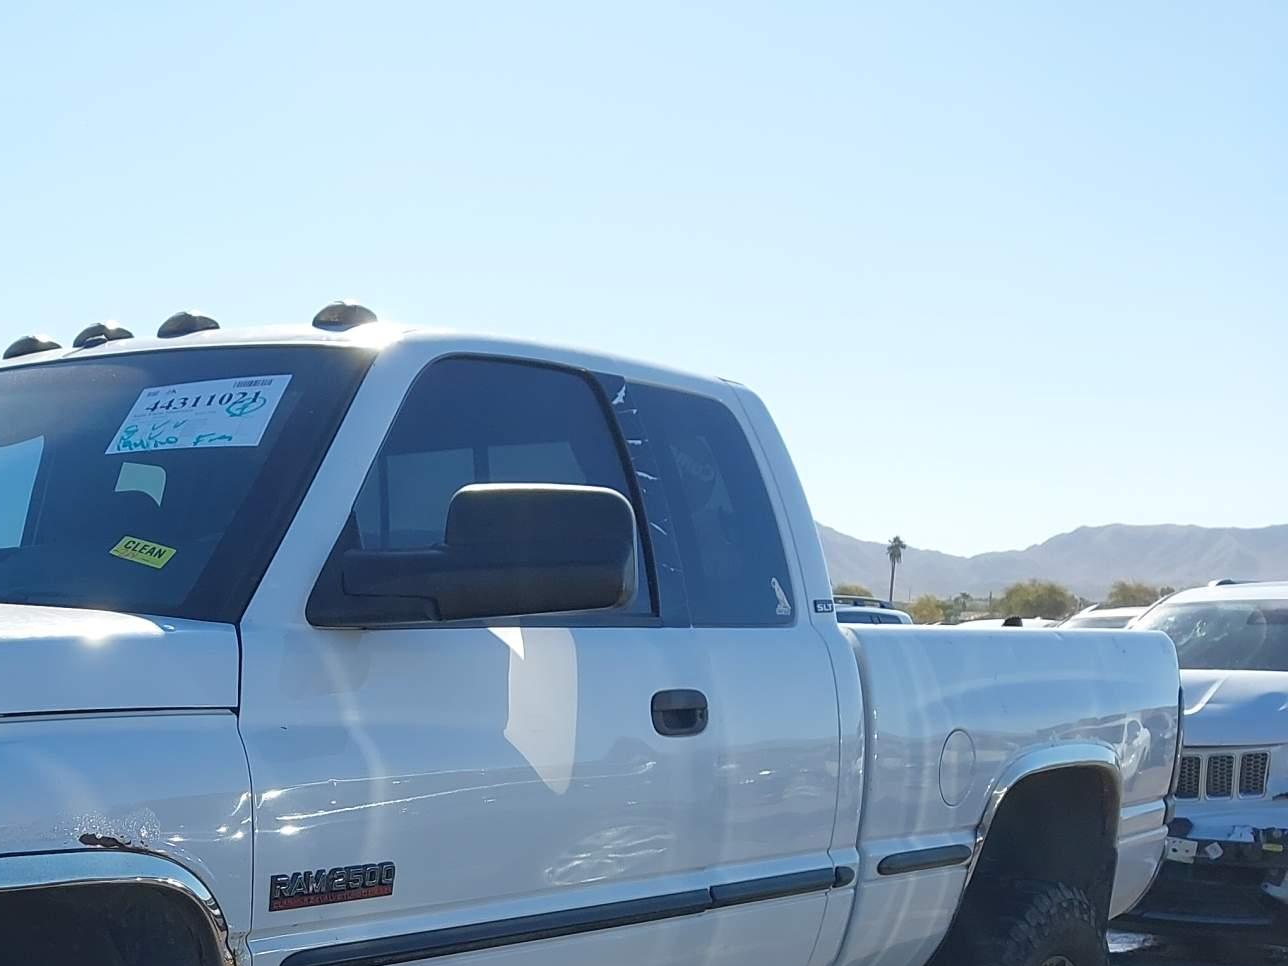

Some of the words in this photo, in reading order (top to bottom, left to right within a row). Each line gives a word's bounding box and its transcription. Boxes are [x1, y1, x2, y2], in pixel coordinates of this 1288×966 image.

[145, 390, 261, 412] 44311021
[124, 540, 167, 559] CLEAN
[817, 603, 832, 611] SLT
[271, 869, 327, 898] RAM
[328, 862, 395, 891] 2500
